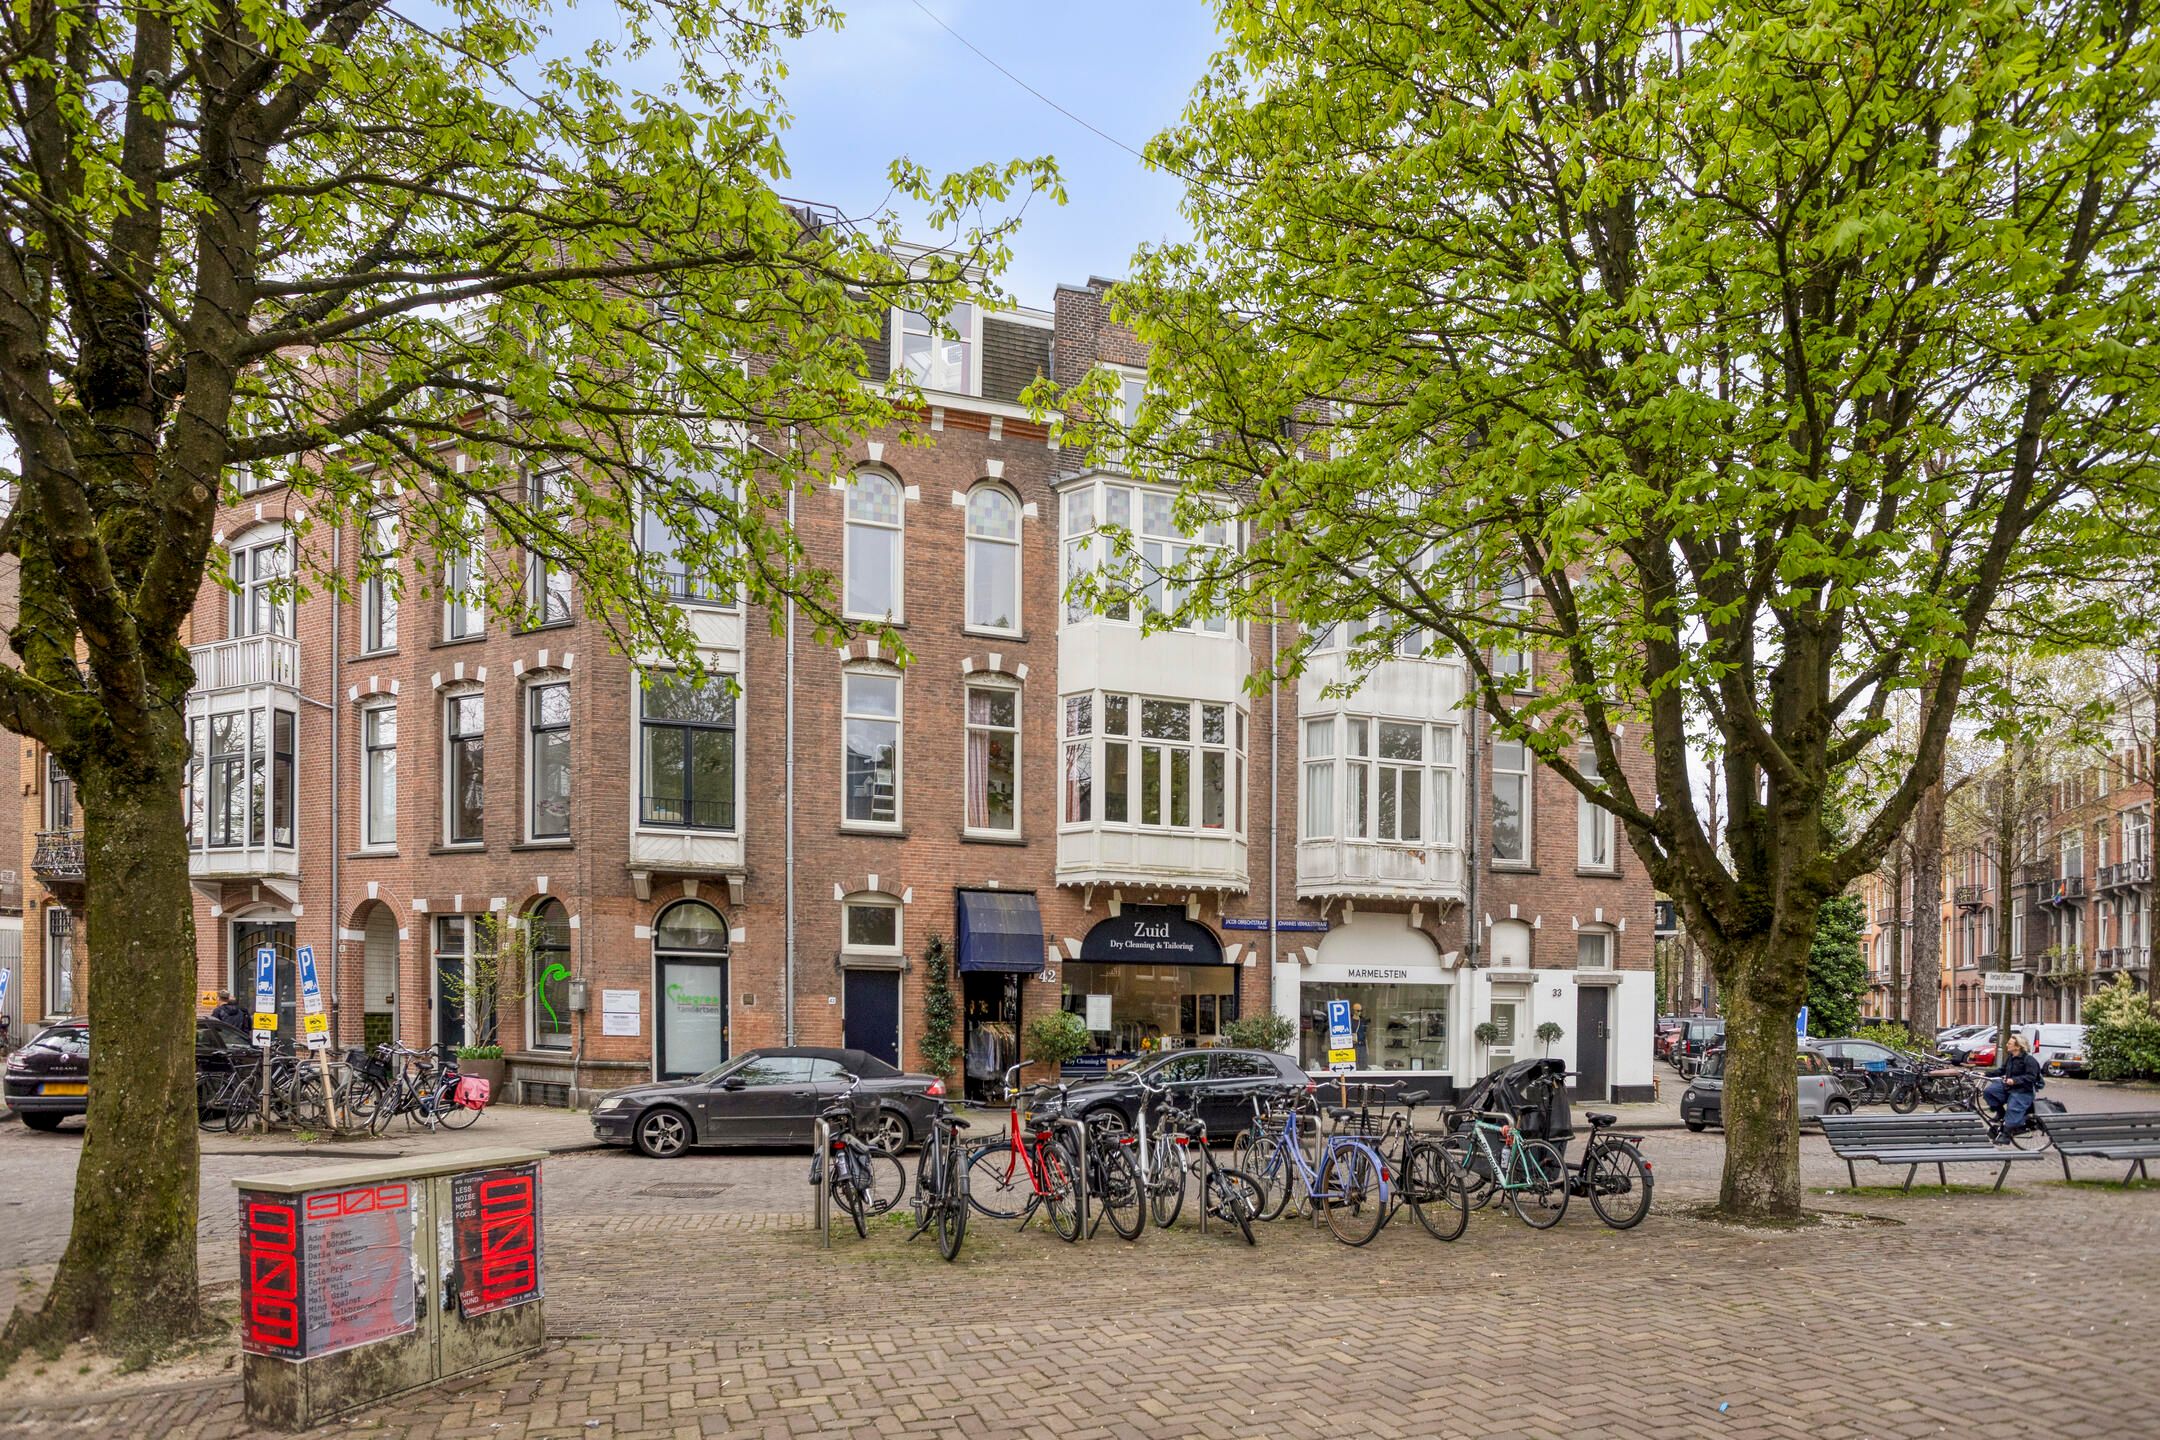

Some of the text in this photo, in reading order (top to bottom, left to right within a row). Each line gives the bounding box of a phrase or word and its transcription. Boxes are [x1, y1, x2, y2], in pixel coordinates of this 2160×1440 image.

[1133, 921, 1170, 938] Zuid
[1110, 939, 1123, 950] Dry
[1124, 940, 1155, 951] Cleaning
[1163, 941, 1194, 952] Tailoring
[261, 952, 271, 977] P
[300, 951, 311, 976] P
[1038, 969, 1057, 983] 42
[1348, 968, 1407, 979] MARMELSTEIN
[1552, 988, 1562, 997] 33
[1333, 1004, 1345, 1022] P
[455, 1185, 472, 1194] LESS
[307, 1184, 408, 1220] 909
[455, 1193, 476, 1203] NOISE
[455, 1201, 472, 1211] MORE
[455, 1209, 477, 1219] FOCUS
[308, 1230, 352, 1242] Adam Beyer
[308, 1244, 321, 1252] Ben
[308, 1251, 331, 1260] Daria
[308, 1269, 326, 1278] Eric
[308, 1274, 343, 1286] Folamour
[309, 1280, 352, 1295] Jeff Mills
[308, 1290, 349, 1304] Mall Grab
[461, 1289, 474, 1298] URE
[308, 1296, 361, 1313] Mind Against
[462, 1296, 479, 1306] OUND
[308, 1313, 326, 1322] Paul
